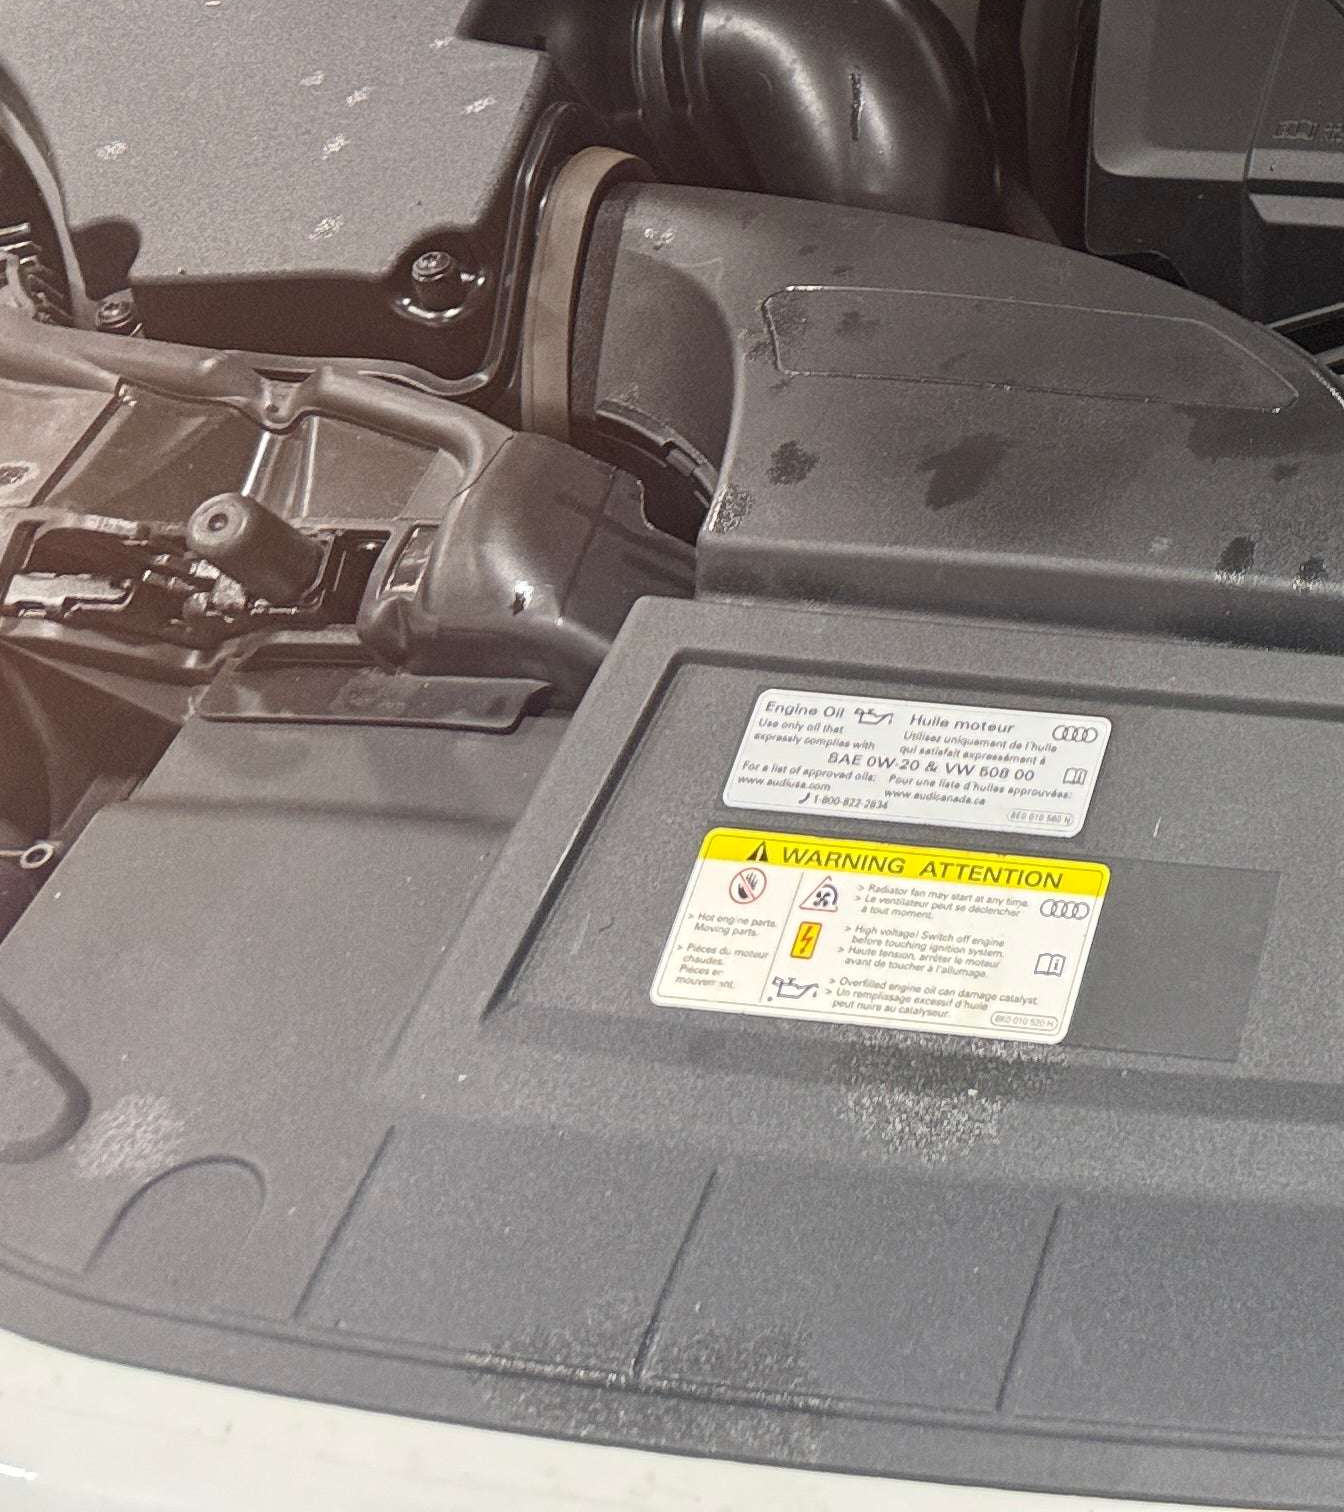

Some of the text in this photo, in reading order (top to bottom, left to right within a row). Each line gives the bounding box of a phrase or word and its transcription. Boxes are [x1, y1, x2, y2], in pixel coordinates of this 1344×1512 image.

[766, 701, 845, 718] Engine Oil
[759, 717, 778, 727] Use
[781, 721, 804, 732] only
[823, 724, 844, 734] that
[910, 714, 1015, 733] Huile moteur
[754, 732, 875, 750] expressly complies with
[944, 735, 1007, 750] uniquement
[1009, 740, 1022, 750] de
[900, 745, 917, 755] qui
[742, 760, 759, 771] For
[771, 763, 788, 774] list
[789, 766, 803, 775] of
[803, 768, 852, 779] approved
[828, 752, 863, 766] SAE
[866, 755, 920, 772] 0W-20
[925, 761, 937, 772] &
[946, 762, 975, 776] VW
[1014, 769, 1035, 781] 00
[888, 774, 913, 785] Pour
[915, 778, 935, 786] une
[938, 779, 960, 790] liste
[782, 847, 1064, 890] WARNING ATTENTION
[868, 884, 908, 896] Radiator
[910, 888, 926, 898] fan
[928, 891, 949, 901] may
[951, 893, 972, 903] start
[975, 895, 984, 903] at
[986, 896, 1003, 906] any
[865, 894, 1021, 917] Le ventilateur peut se déclencher
[870, 906, 889, 915] tout
[891, 908, 933, 920] moment.
[698, 912, 715, 922] Hot
[717, 915, 749, 925] engine
[694, 922, 758, 937] Moving parts.
[855, 925, 878, 936] High
[921, 931, 954, 942] Switch
[957, 934, 971, 944] off
[972, 937, 1005, 948] engine
[719, 946, 731, 955] du
[734, 949, 769, 959] moteur
[851, 935, 883, 947] before
[885, 939, 927, 952] touching
[929, 943, 970, 954] ignition
[844, 957, 872, 968] avant
[874, 959, 886, 968] de
[888, 962, 926, 972] toucher
[848, 946, 877, 956] Haute
[954, 956, 962, 965] le
[965, 959, 1000, 969] moteur
[839, 976, 887, 990] Overfilled
[889, 983, 922, 994] engine
[923, 985, 937, 995] oil
[938, 988, 956, 997] can
[958, 989, 998, 1002] damage
[832, 999, 854, 1009] peut
[856, 1002, 882, 1012] nuire
[884, 1005, 897, 1013] au
[836, 988, 989, 1011] Un remplissage excessif d'huile
[1013, 1017, 1028, 1025] 010
